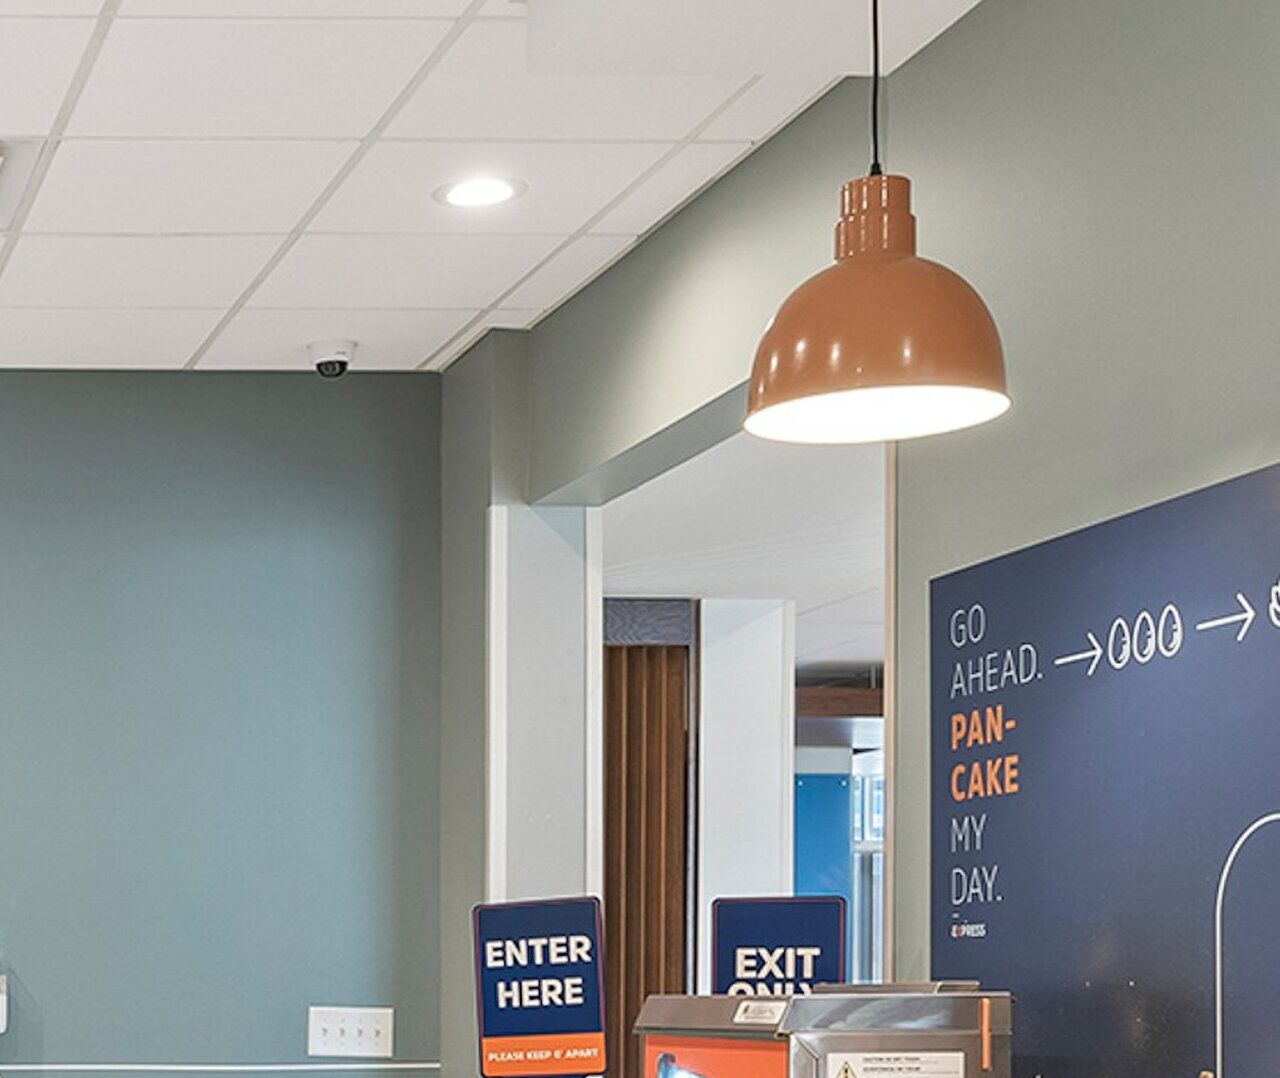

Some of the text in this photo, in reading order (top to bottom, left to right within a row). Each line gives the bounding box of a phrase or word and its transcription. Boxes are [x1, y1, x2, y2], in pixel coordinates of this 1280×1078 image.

[950, 603, 986, 648] GO
[950, 643, 1043, 699] AHEAD.
[951, 704, 1016, 750] PAN-
[950, 754, 1019, 801] CAKE
[951, 812, 988, 853] MY
[951, 864, 1002, 905] DAY.
[485, 935, 593, 968] ENTER
[735, 947, 821, 979] EXIT
[497, 977, 584, 1009] HERE
